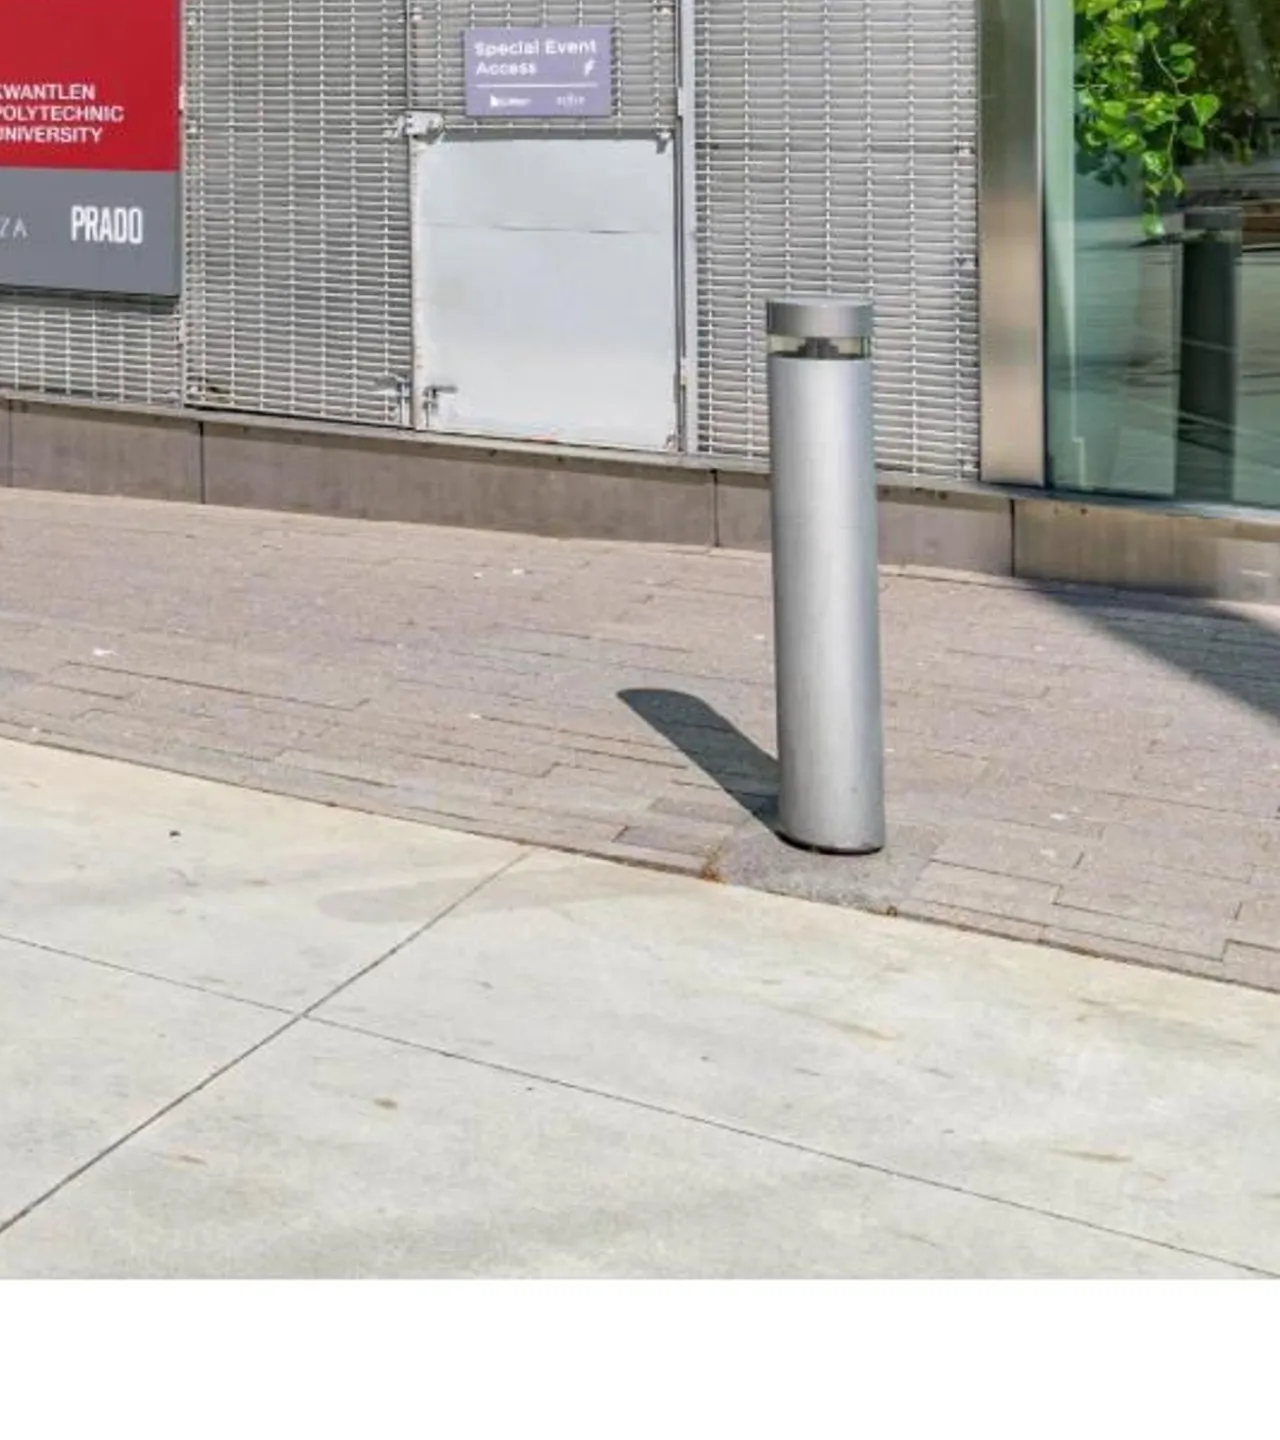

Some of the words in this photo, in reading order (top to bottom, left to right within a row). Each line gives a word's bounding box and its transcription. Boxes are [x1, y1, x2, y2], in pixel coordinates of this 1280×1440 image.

[474, 39, 540, 58] Special
[545, 39, 598, 55] Event
[476, 61, 537, 76] Access
[70, 205, 143, 244] PRADO
